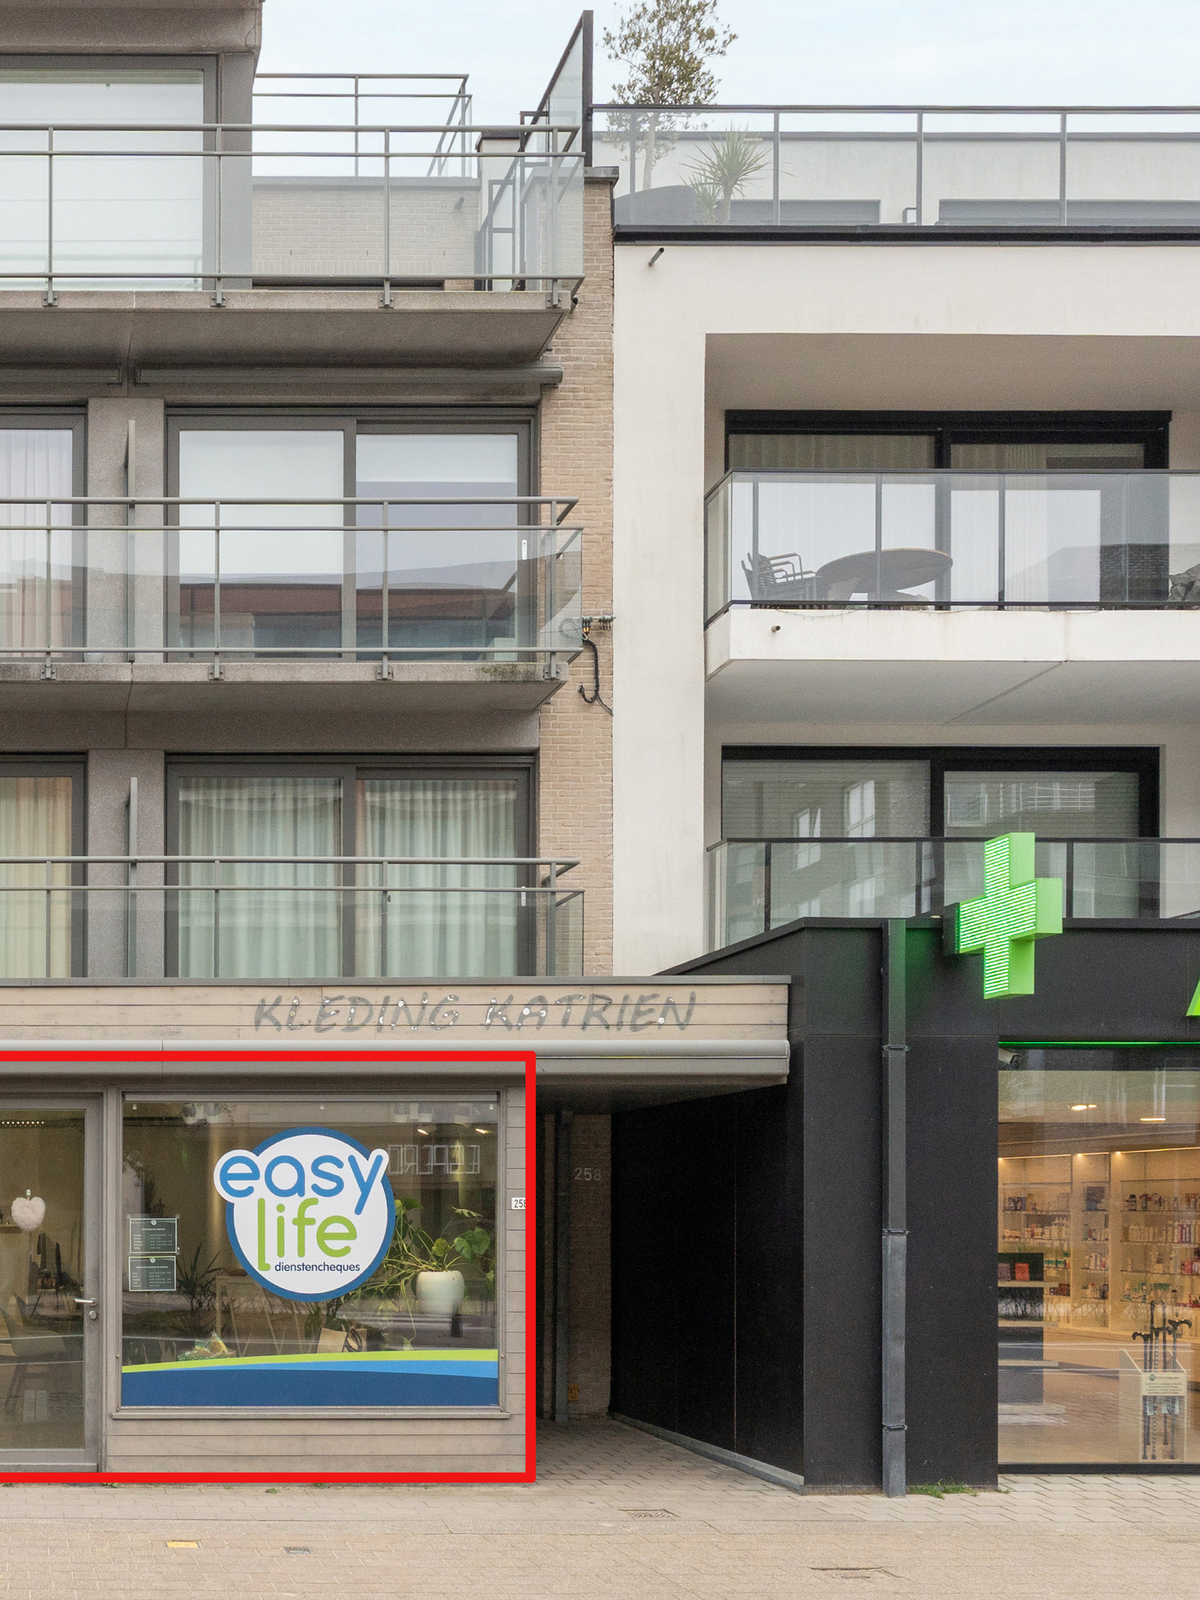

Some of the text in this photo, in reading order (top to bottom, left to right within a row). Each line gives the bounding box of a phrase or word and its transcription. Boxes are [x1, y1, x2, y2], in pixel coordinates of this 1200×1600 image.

[253, 991, 696, 1034] KLEDING KATRIEN
[219, 1154, 384, 1216] easy
[574, 1167, 602, 1181] 258
[257, 1197, 358, 1272] life
[274, 1262, 361, 1274] dienstencheques
